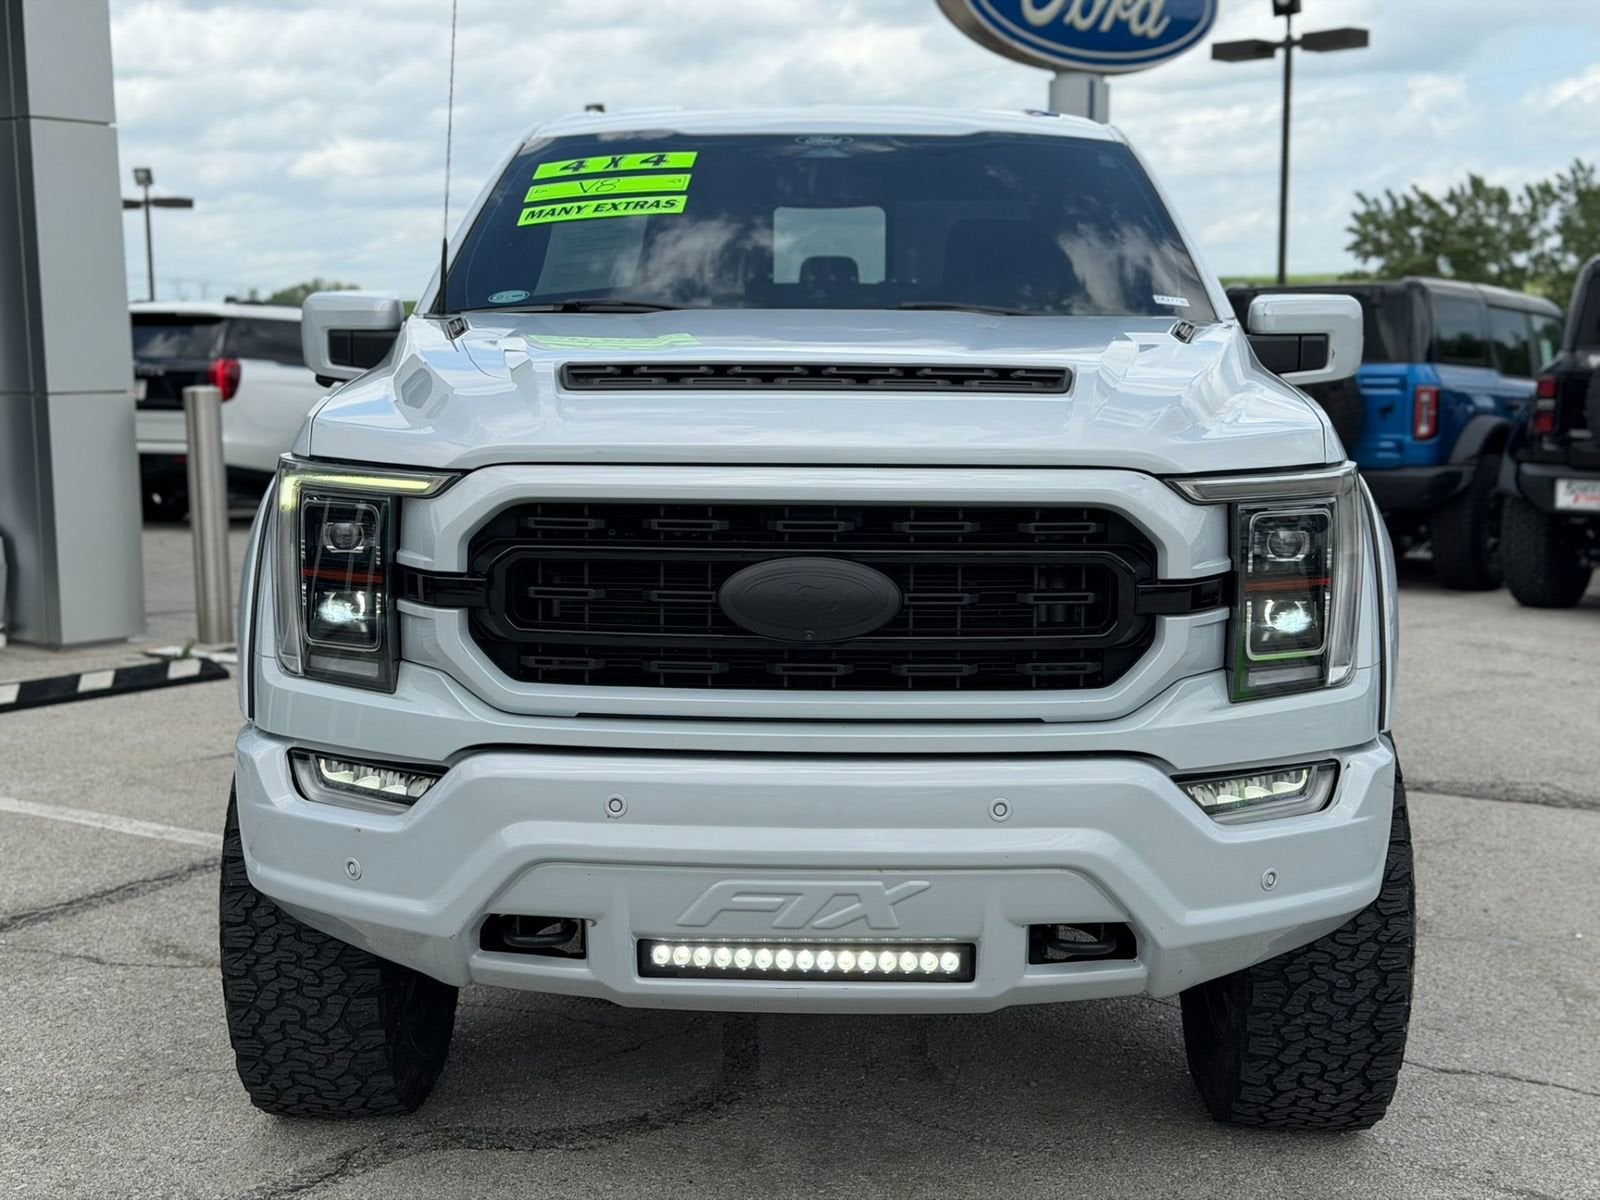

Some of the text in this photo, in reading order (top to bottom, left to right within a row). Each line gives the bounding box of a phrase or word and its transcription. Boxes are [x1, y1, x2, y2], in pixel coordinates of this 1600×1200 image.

[560, 154, 667, 173] 4 X 4
[578, 178, 621, 194] V8
[525, 199, 678, 221] MANY EXTRAS
[675, 879, 931, 929] FTX
